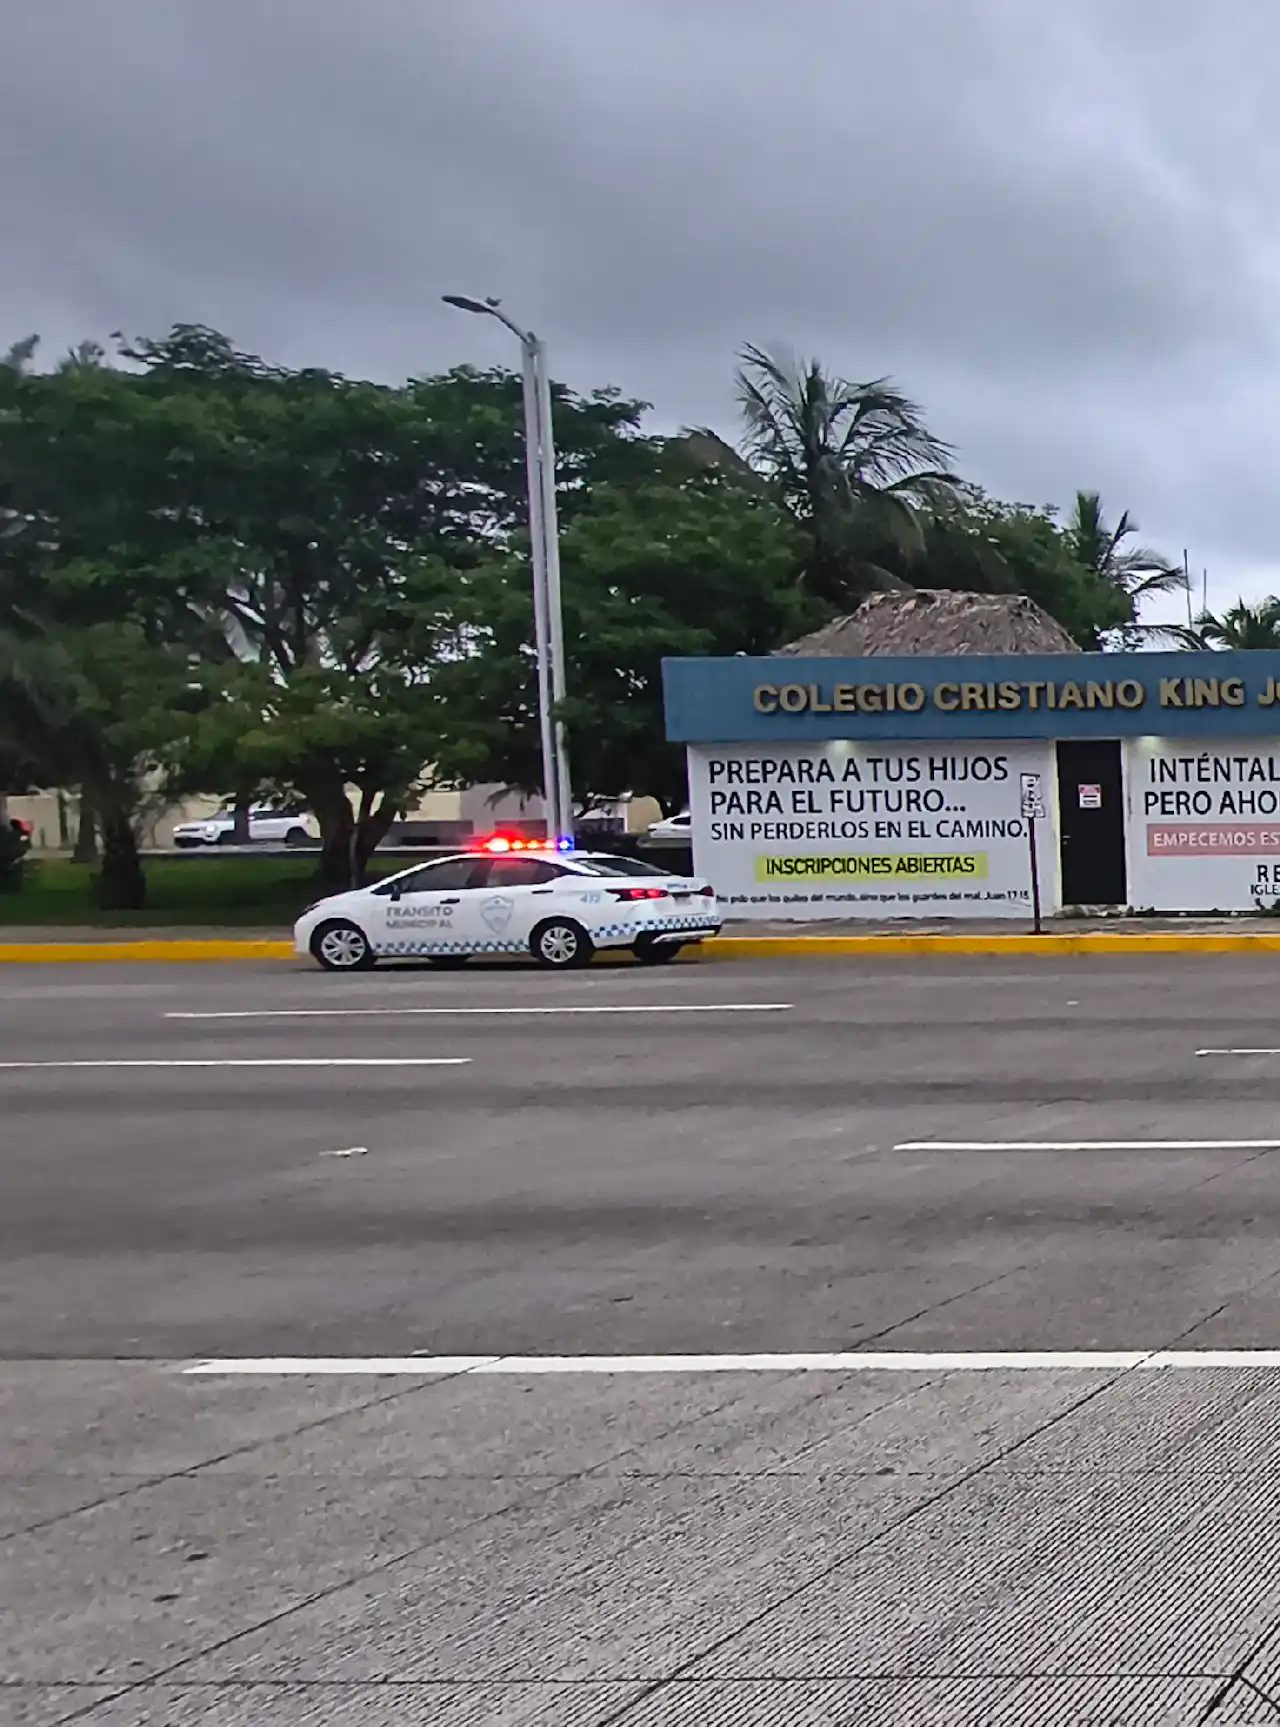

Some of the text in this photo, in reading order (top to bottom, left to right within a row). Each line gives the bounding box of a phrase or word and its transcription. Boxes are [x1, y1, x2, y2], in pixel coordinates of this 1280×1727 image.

[753, 683, 925, 712] COLEGIO
[933, 678, 1144, 709] CRISTIANO
[1159, 677, 1246, 706] KING
[709, 756, 1008, 784] PREPARA A TUS HIJOS
[711, 788, 967, 815] PARA EL FUTURO...
[1144, 790, 1212, 815] PERO
[711, 818, 1028, 840] SIN PERDERLOS EN EL CAMINO.
[1153, 832, 1256, 848] EMPECEMOS
[766, 855, 975, 874] INSCRIPCIONES ABIERTAS
